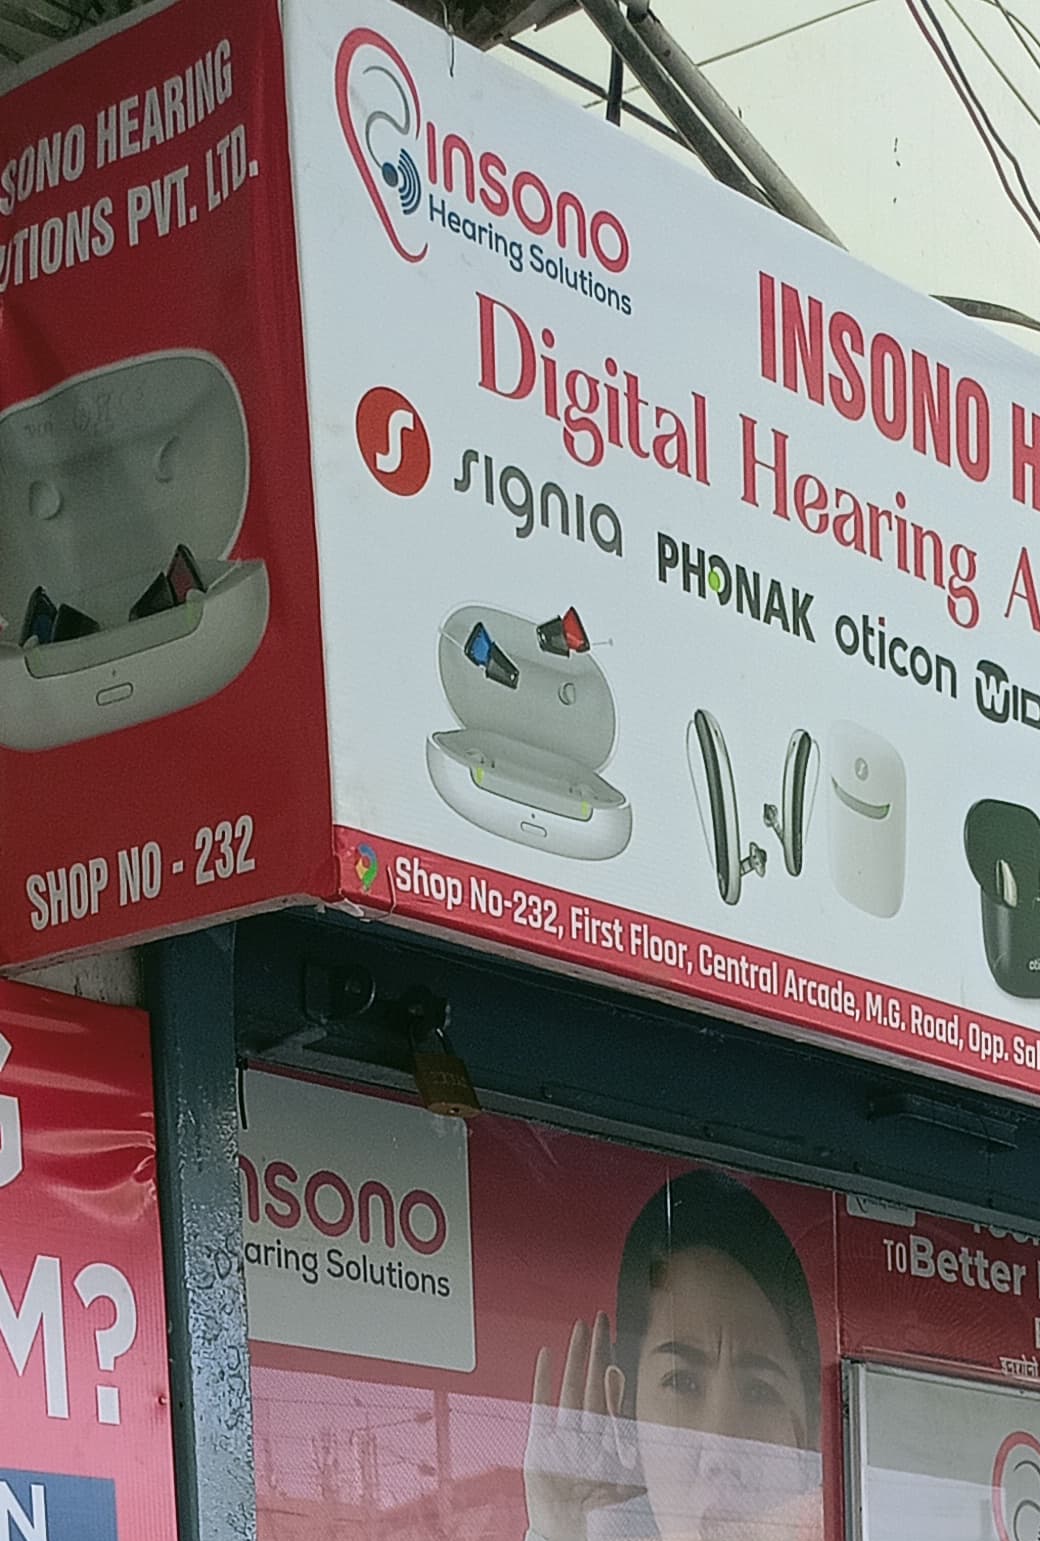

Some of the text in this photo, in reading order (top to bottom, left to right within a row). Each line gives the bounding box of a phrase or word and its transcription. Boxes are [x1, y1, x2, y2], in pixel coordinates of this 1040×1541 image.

[97, 38, 233, 169] HEARING
[127, 164, 198, 247] PVT.
[205, 123, 259, 212] LTD.
[429, 194, 632, 316] Hearing Solutions
[758, 270, 991, 484] INSONO
[475, 291, 712, 487] Digital
[739, 413, 981, 630] Hearing
[454, 448, 624, 558] signia
[656, 531, 816, 643] PHONAK
[834, 614, 958, 700] oticon
[26, 857, 109, 931] SHOP
[117, 842, 163, 907] NO
[194, 814, 257, 886] 232
[395, 855, 463, 910] Shop
[469, 875, 564, 940] No-232,
[570, 907, 625, 953] First
[629, 923, 695, 976] Floor,
[698, 943, 779, 997] Central
[783, 966, 861, 1023] Arcade,
[865, 990, 906, 1031] M.G.
[910, 1003, 964, 1052] Road,
[968, 1021, 1010, 1064] Opp.
[244, 1240, 451, 1297] aring Solutions
[883, 1238, 908, 1274] TO
[909, 1233, 1027, 1297] Better
